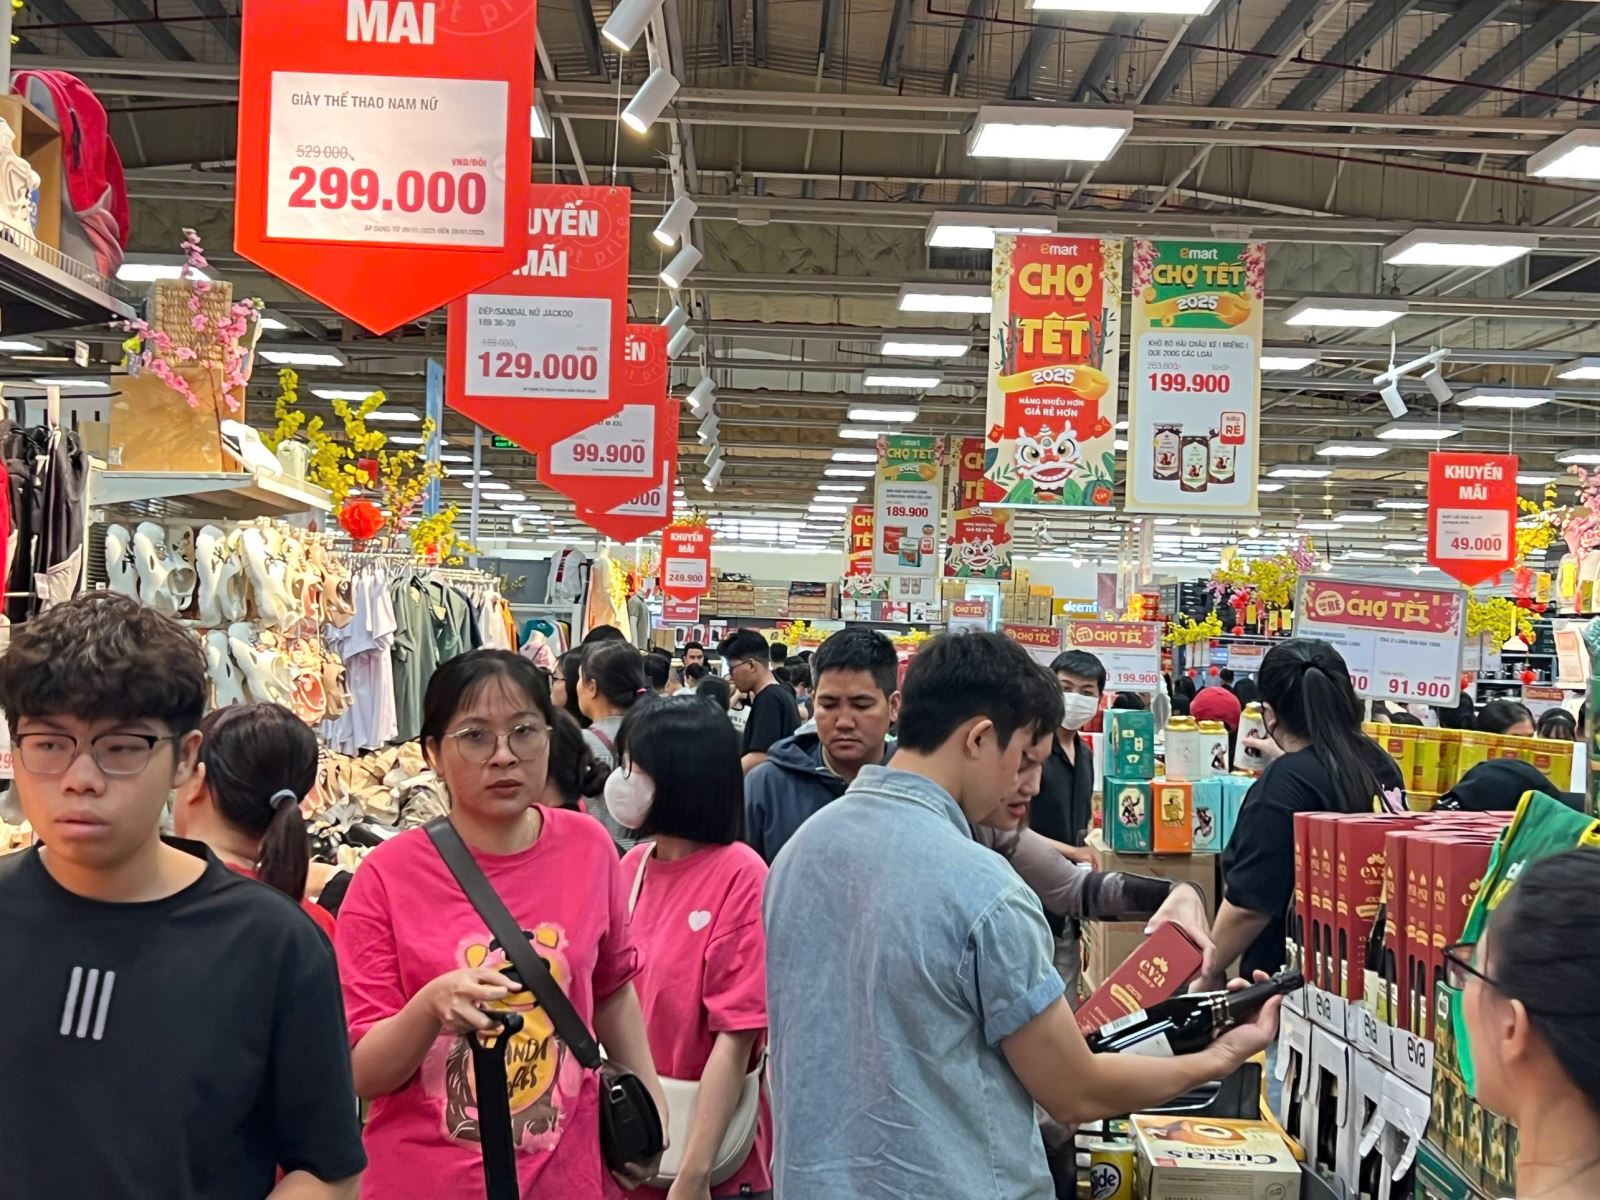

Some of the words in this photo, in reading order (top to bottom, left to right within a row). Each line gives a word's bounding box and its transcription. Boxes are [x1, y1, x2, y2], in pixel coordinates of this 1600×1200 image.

[291, 91, 321, 106] GIÀY
[350, 95, 384, 109] THAO
[388, 97, 417, 110] NAM
[420, 96, 439, 111] NỮ
[288, 165, 487, 215] 299.000
[528, 199, 599, 237] UYẾN
[512, 243, 568, 277] MÃI
[1039, 243, 1079, 257] emart
[1179, 246, 1219, 261] emart
[1018, 261, 1094, 302] CHỢ
[1152, 263, 1199, 290] CHỢ
[1202, 261, 1247, 288] TẾT
[1176, 294, 1219, 312] 2025
[1017, 310, 1091, 356] TẾT
[478, 351, 598, 381] 129.000
[1031, 367, 1076, 386] 2025
[1148, 372, 1231, 394] 199.900
[1024, 405, 1041, 416] GIÁ
[1056, 408, 1078, 417] HƠN
[572, 443, 646, 464] 99.900
[886, 448, 910, 460] CHỢ
[912, 447, 935, 460] TẾT
[1444, 461, 1503, 481] KHUYẾN
[1458, 483, 1488, 501] MÃI
[886, 506, 929, 518] 189.900
[1451, 537, 1502, 551] 49.000
[1346, 598, 1388, 621] CHỢ
[1391, 599, 1430, 621] TẾT
[1094, 630, 1118, 643] CHỢ
[1119, 630, 1142, 642] TẾT
[1118, 672, 1158, 684] 199.900
[1389, 678, 1450, 699] 91.900
[1138, 957, 1167, 988] eva
[1407, 1036, 1426, 1069] eva
[1166, 1150, 1279, 1166] Custas
